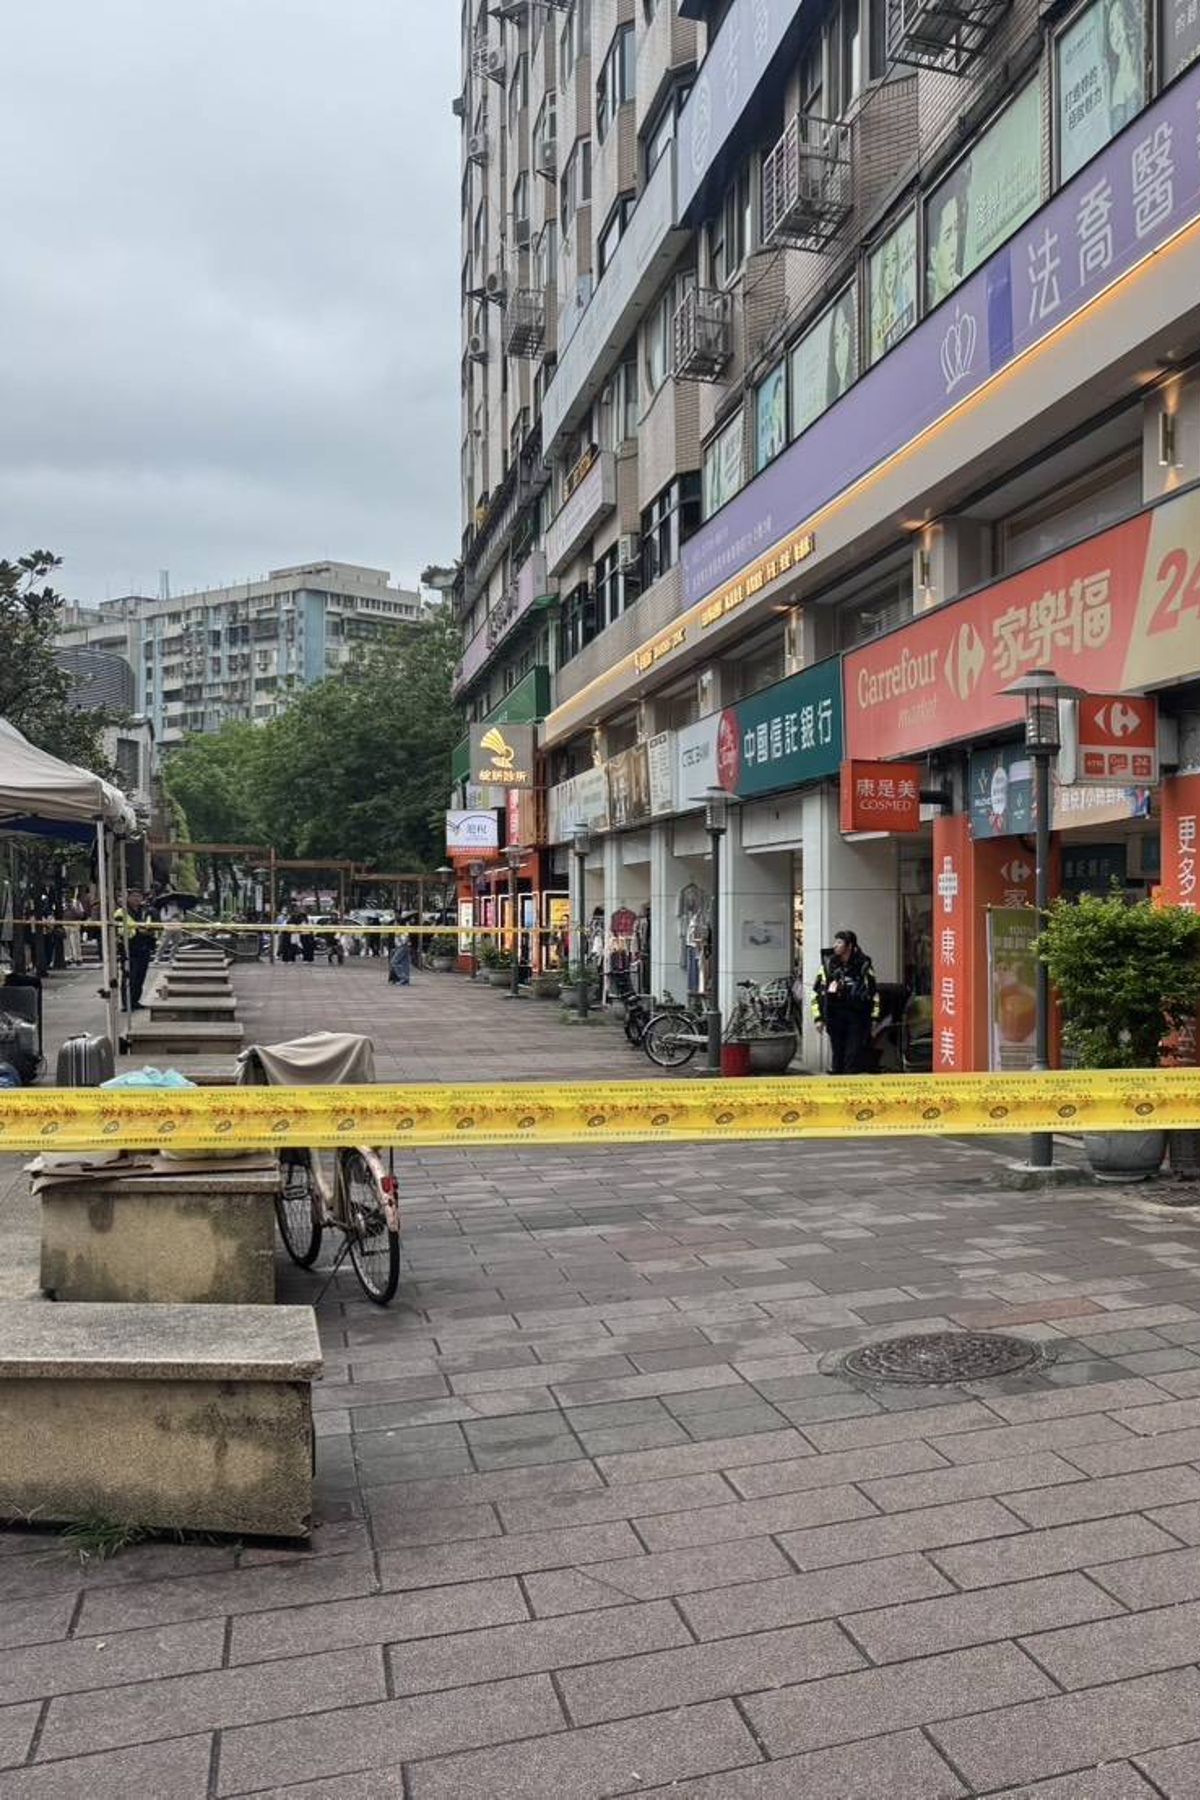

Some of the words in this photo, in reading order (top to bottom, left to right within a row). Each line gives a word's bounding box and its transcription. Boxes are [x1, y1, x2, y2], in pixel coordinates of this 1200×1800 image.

[991, 569, 1113, 680] 家樂福
[857, 647, 939, 710] Carrefour
[743, 698, 833, 768] 中國信託銀行
[856, 778, 917, 799] 康是美
[859, 799, 912, 811] COSMED
[940, 926, 957, 1067] 康是美
